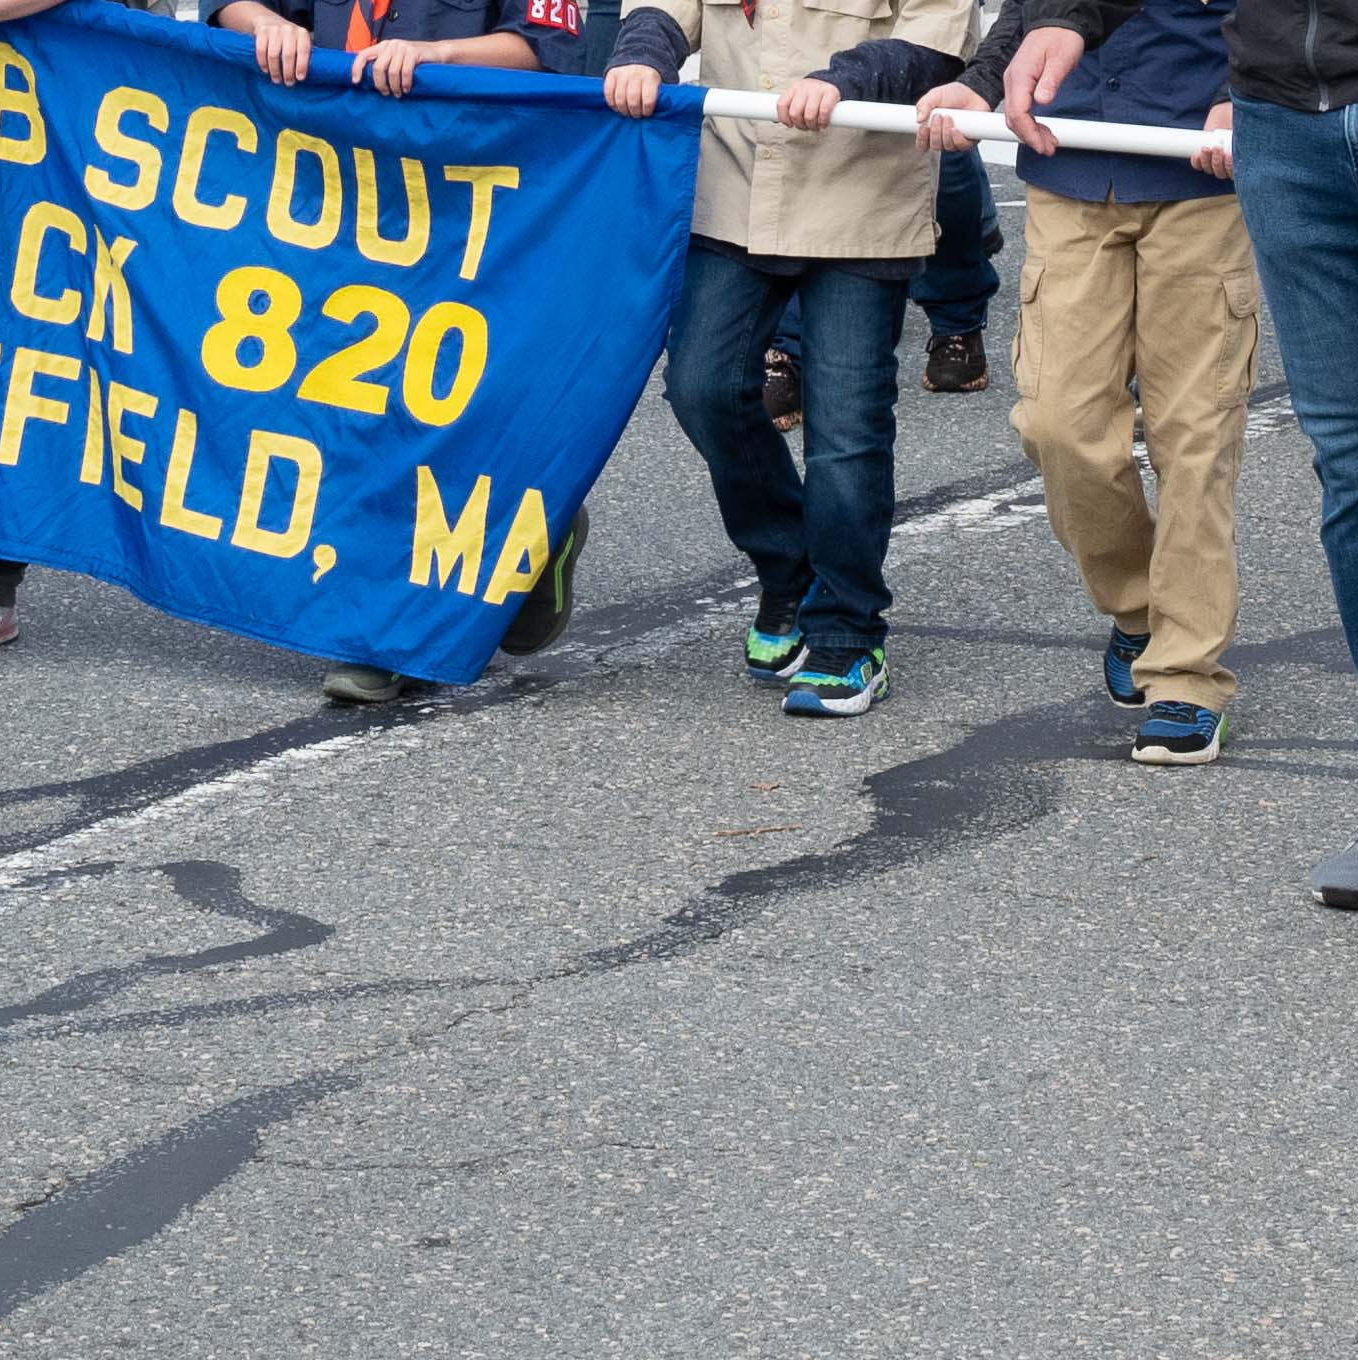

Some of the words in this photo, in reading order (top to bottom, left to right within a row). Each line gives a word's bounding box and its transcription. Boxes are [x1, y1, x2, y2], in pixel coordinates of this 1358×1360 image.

[83, 86, 520, 280] SCOUT
[200, 265, 488, 427] 820
[408, 464, 551, 605] MA
